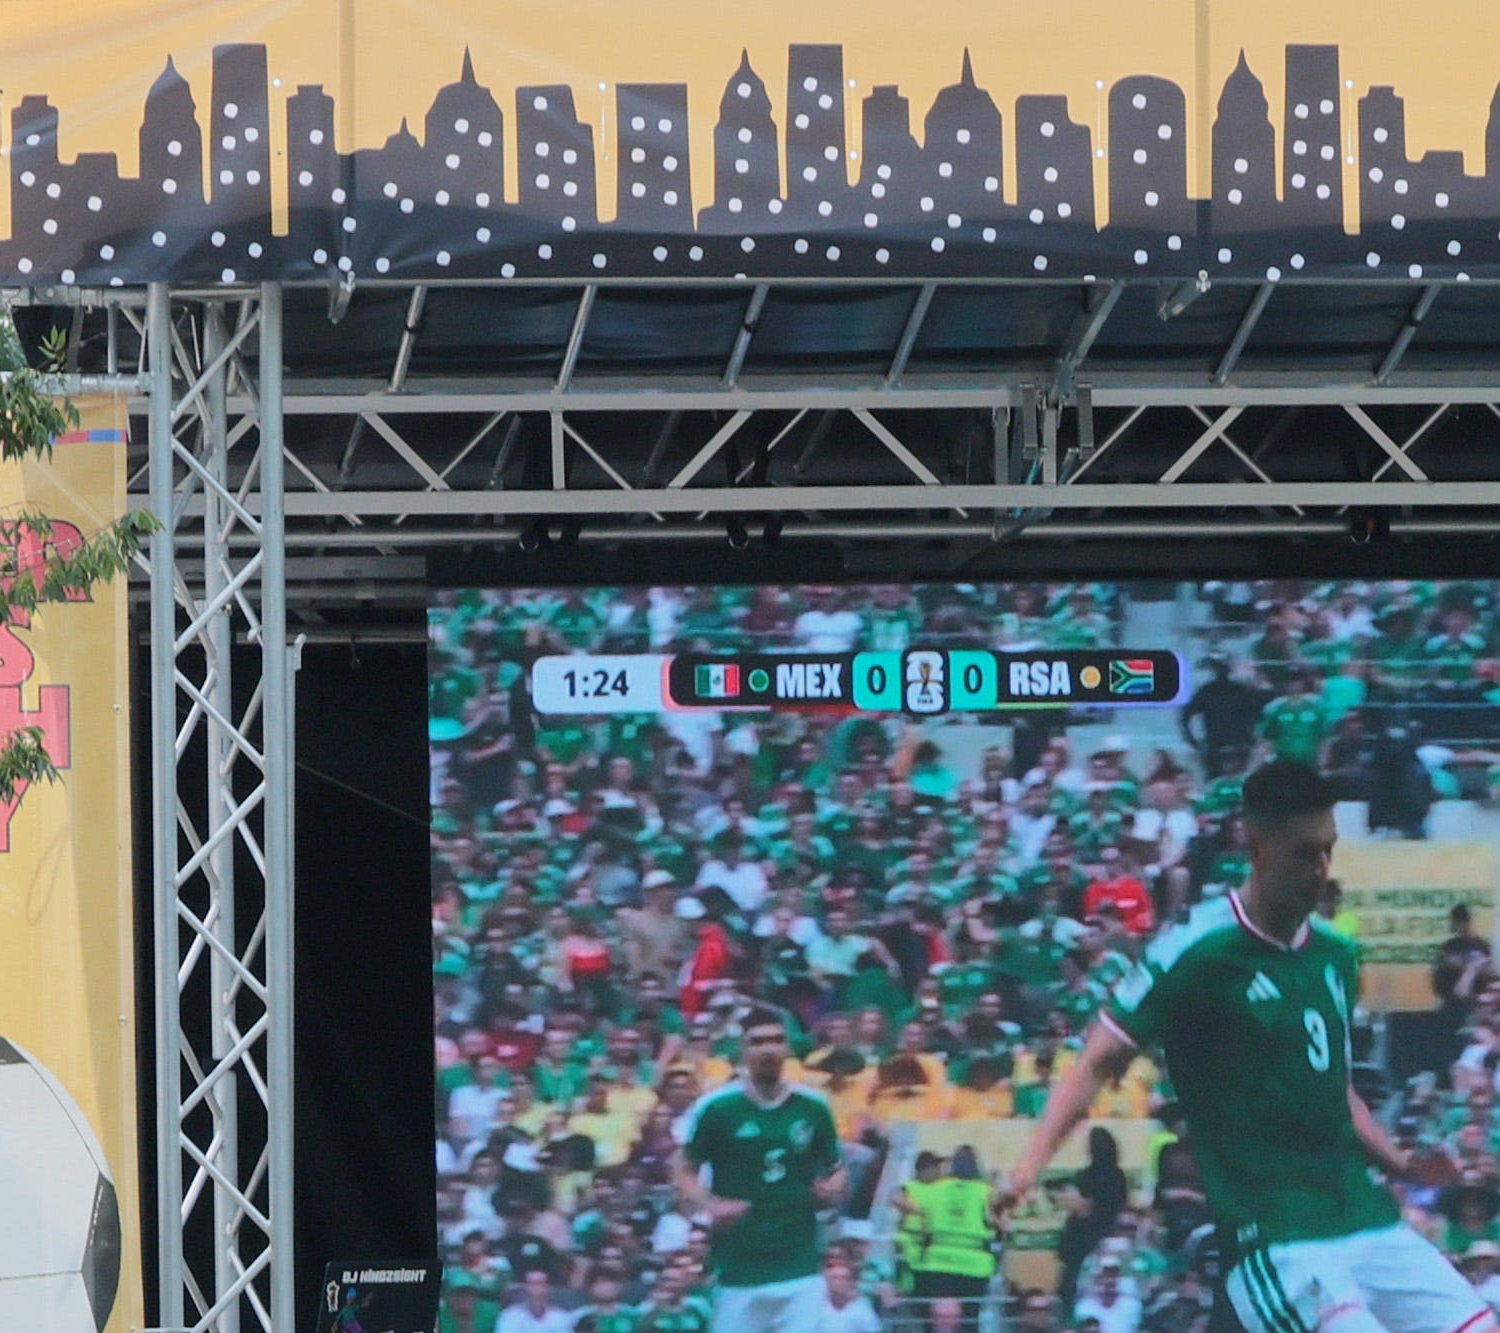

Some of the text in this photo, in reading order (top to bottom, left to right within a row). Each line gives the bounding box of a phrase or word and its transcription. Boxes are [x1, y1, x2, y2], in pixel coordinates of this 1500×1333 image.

[562, 668, 630, 699] 1:24
[776, 663, 888, 700] MEX 0
[963, 663, 1072, 696] 0 RSA
